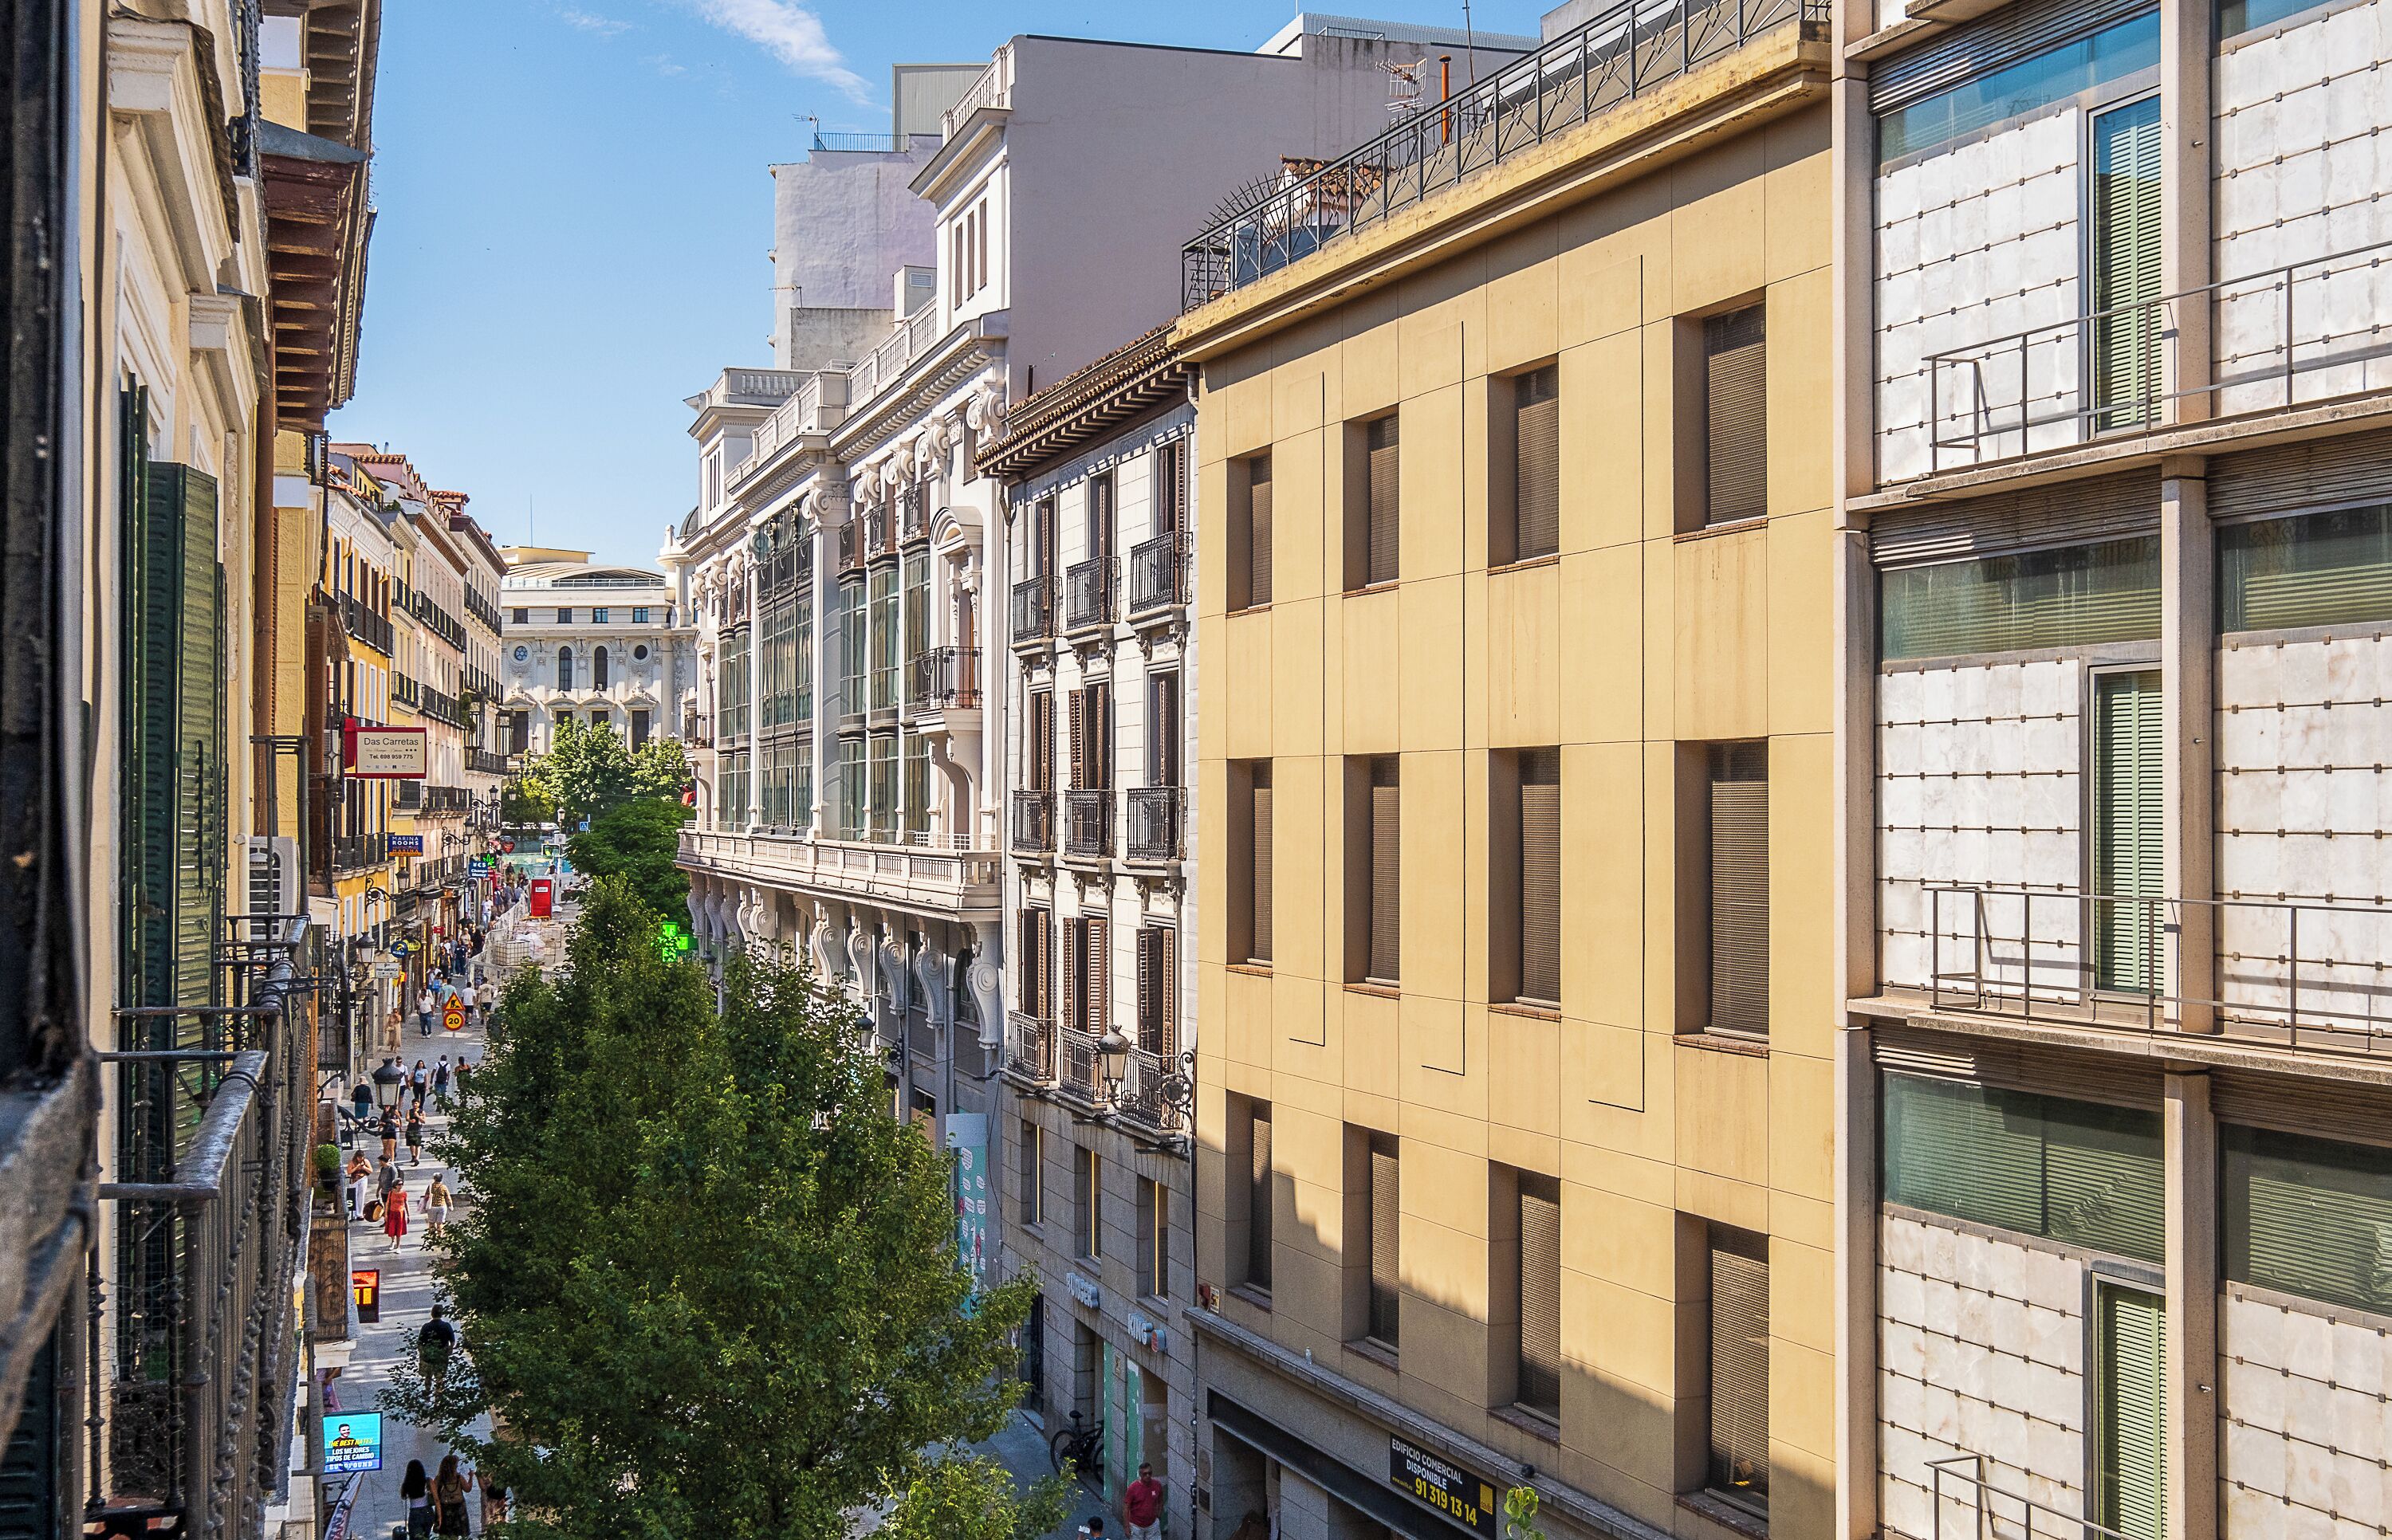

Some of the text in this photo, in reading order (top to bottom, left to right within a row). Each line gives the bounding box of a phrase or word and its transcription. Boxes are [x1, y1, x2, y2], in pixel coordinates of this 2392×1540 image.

[1392, 1438, 1463, 1485] EDIFICIO COMERCIAL
[1406, 1459, 1447, 1491] DISPONIBLE
[1415, 1477, 1477, 1526] 91 319 13 14
